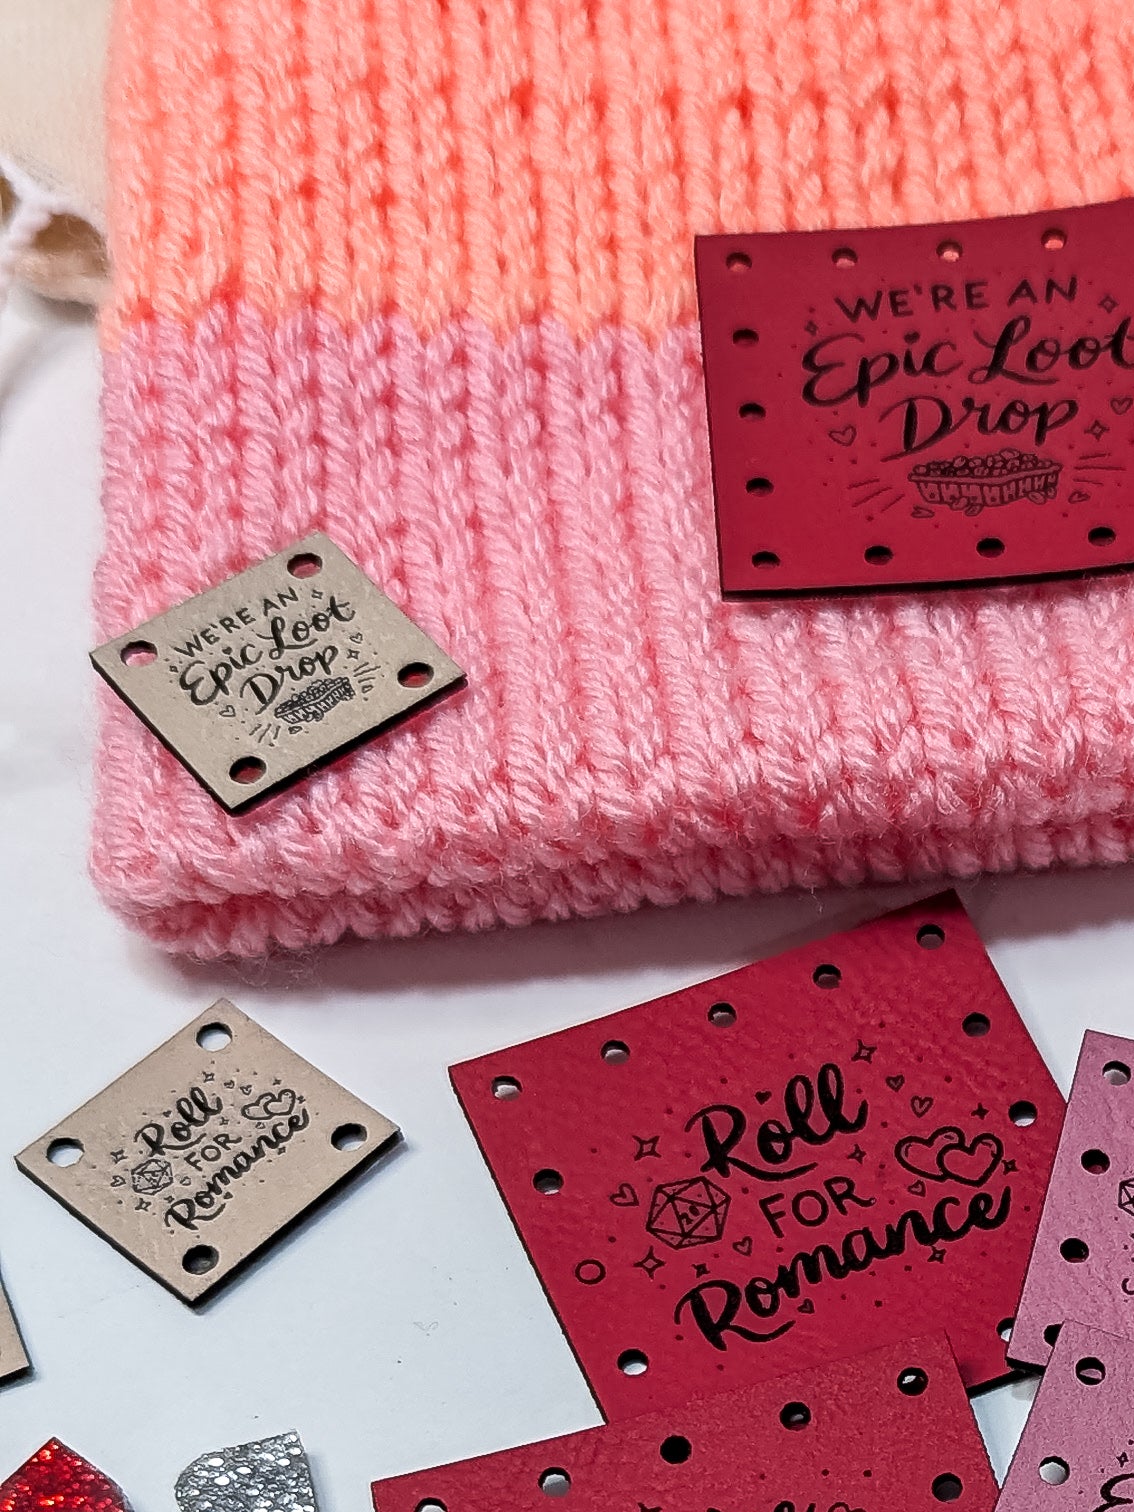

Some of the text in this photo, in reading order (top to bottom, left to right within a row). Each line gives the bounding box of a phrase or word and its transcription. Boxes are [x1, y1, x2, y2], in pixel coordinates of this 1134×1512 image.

[835, 276, 1078, 323] WE'RE AN
[801, 330, 964, 407] Epic
[879, 393, 1078, 462] Drop
[174, 587, 299, 658] WE'RE AN
[179, 596, 356, 706] Epic Loot
[239, 645, 339, 716] Drop
[134, 1086, 223, 1156] Roll
[184, 1132, 242, 1172] FOR
[684, 1063, 869, 1181] Roll
[164, 1108, 310, 1231] Romance
[759, 1176, 876, 1238] FOR
[674, 1186, 1011, 1351] Romance
